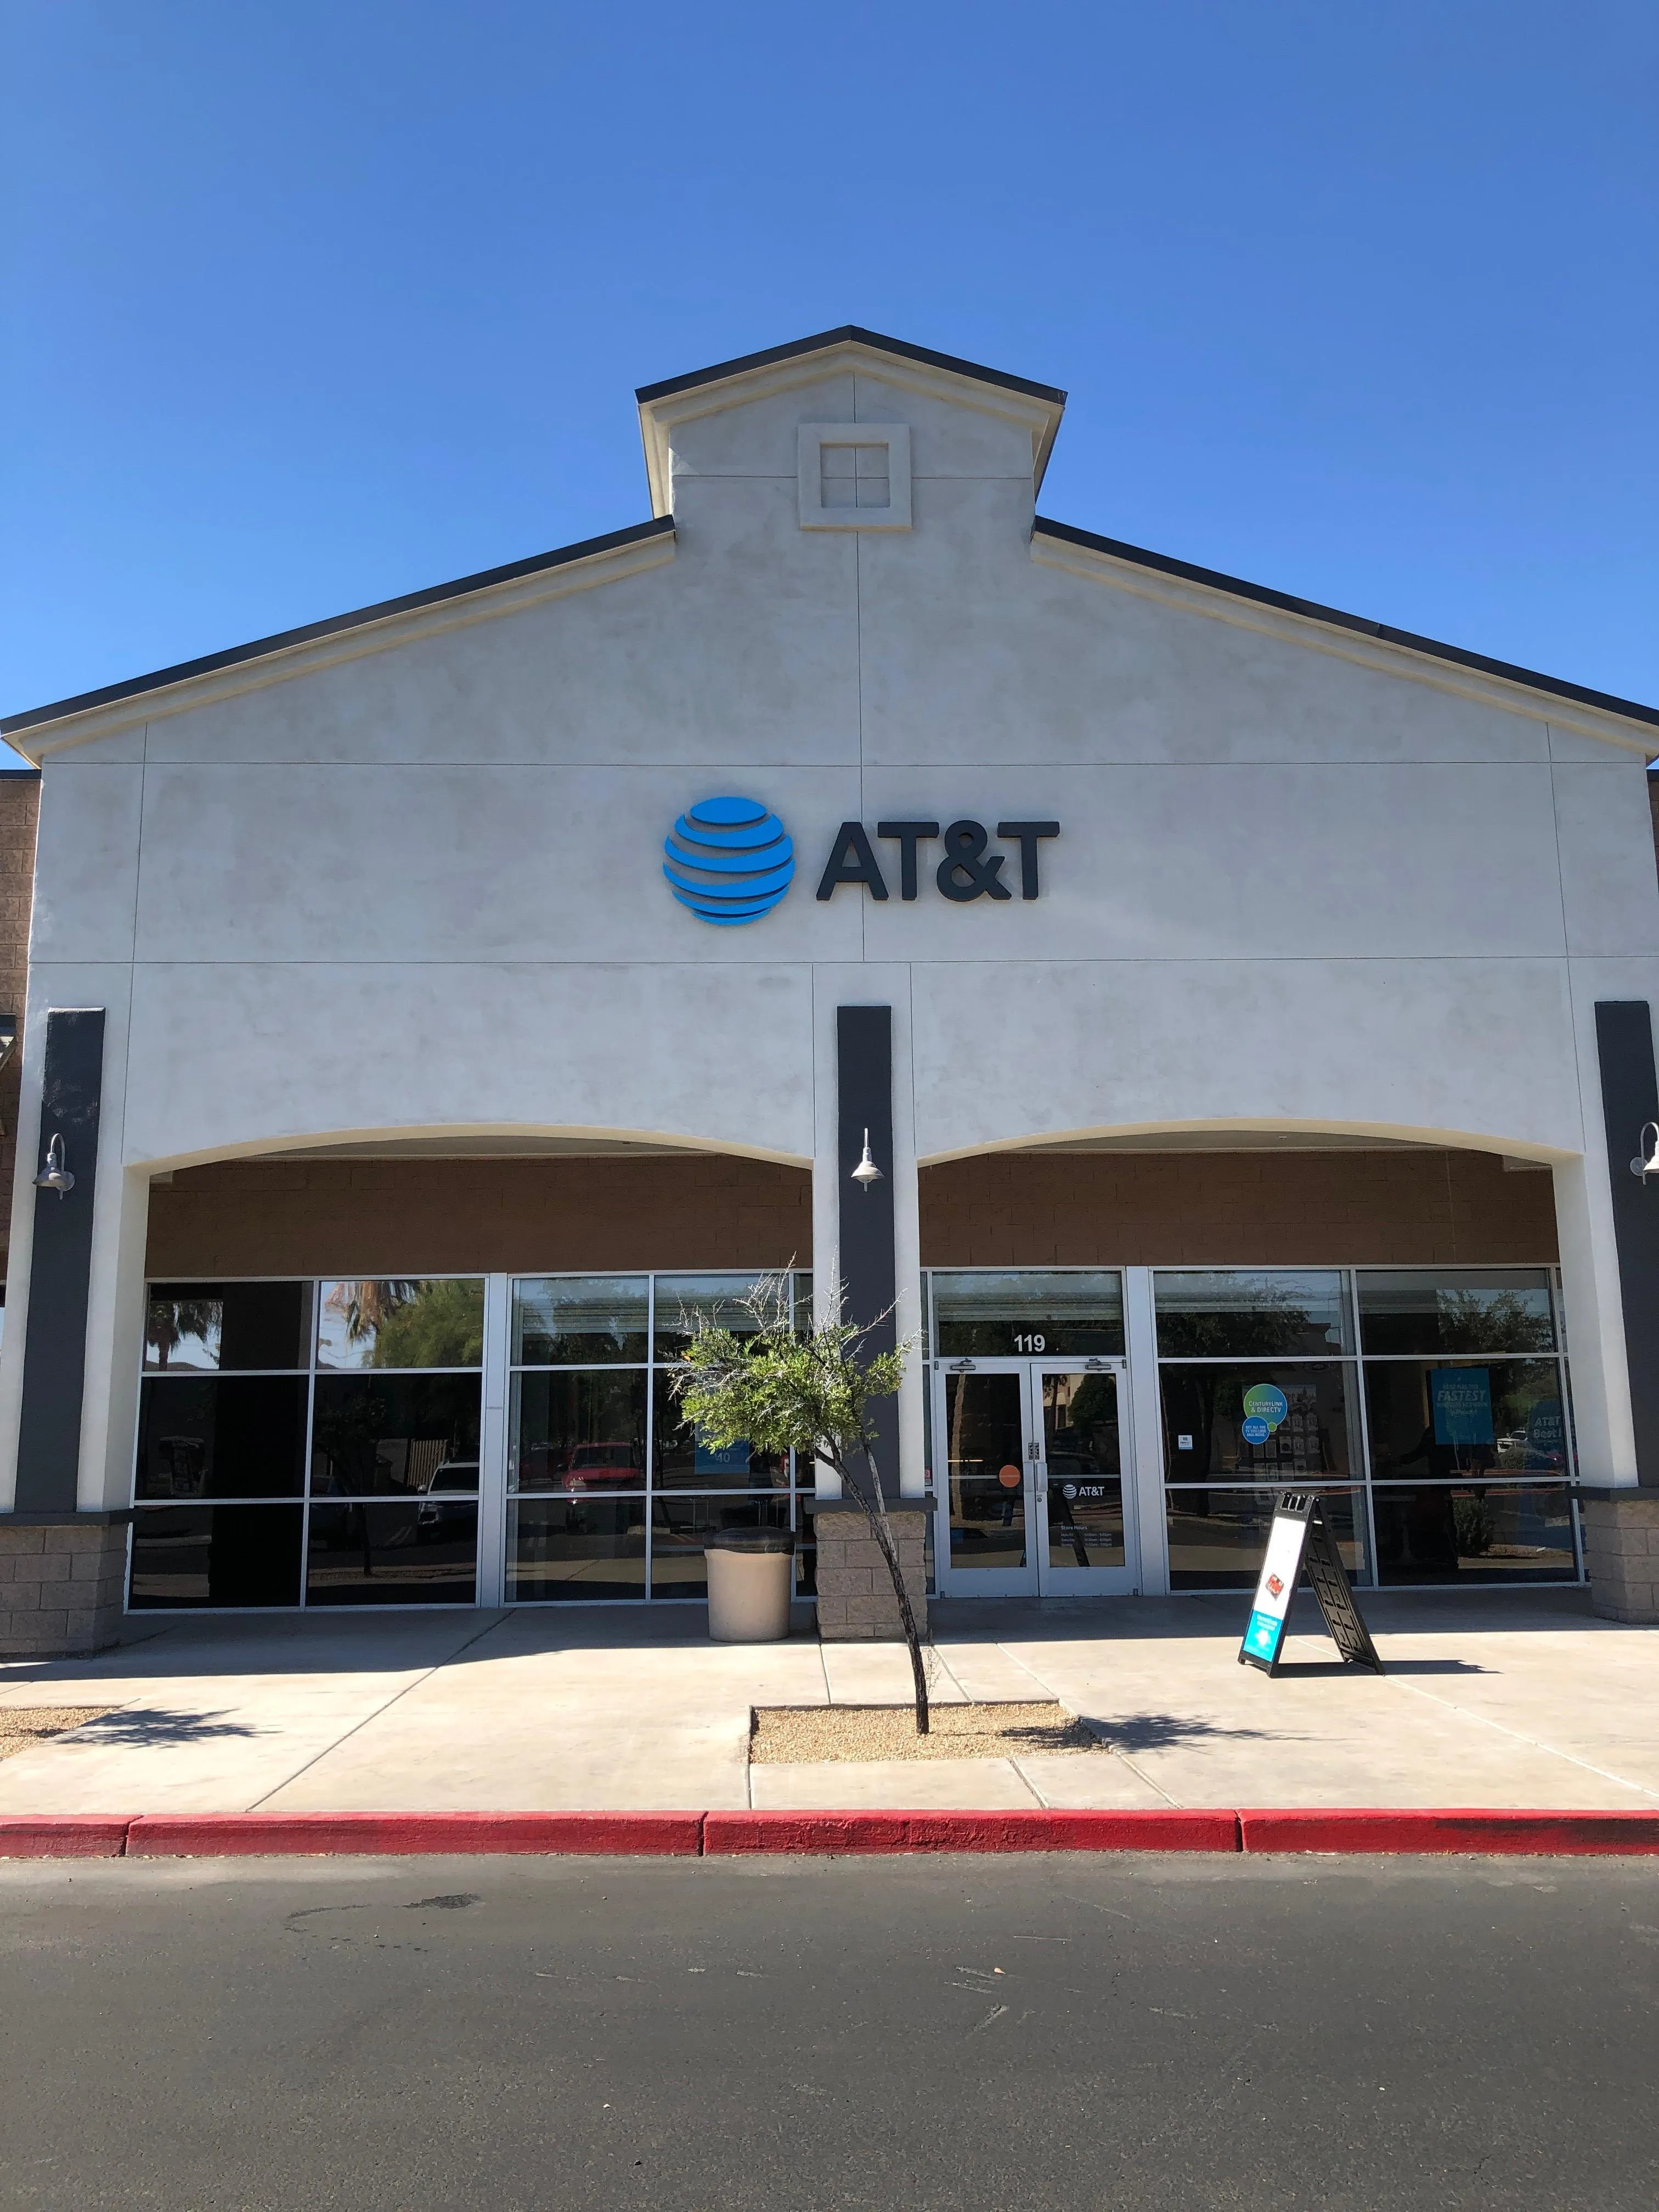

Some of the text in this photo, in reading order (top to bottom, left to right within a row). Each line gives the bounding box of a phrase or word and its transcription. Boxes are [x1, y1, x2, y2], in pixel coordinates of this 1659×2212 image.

[816, 820, 1060, 902] AT&T
[1014, 1334, 1045, 1352] 119
[1437, 1389, 1486, 1402] FASTEST
[1079, 1486, 1105, 1496] AT&T
